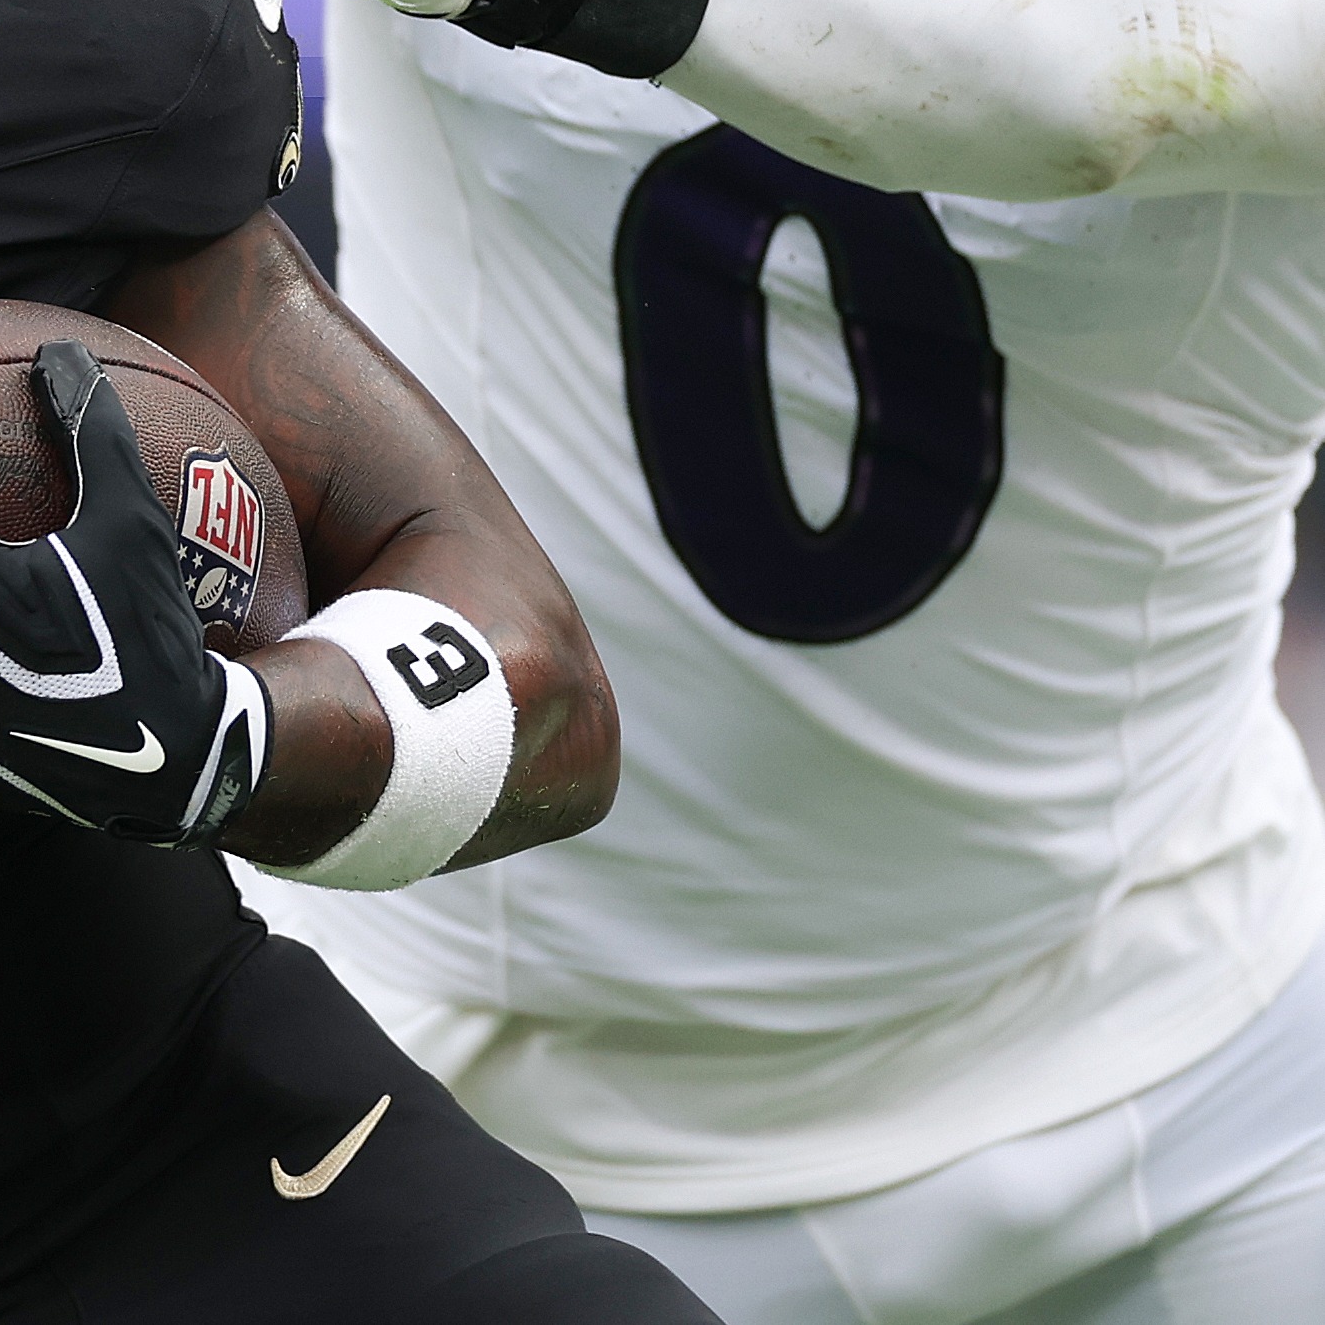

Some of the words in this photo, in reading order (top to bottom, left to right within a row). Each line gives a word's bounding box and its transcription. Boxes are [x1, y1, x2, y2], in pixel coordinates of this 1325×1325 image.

[613, 121, 1006, 645] 0
[192, 465, 257, 568] NFL
[386, 621, 490, 710] 3
[205, 774, 241, 827] NIKE
